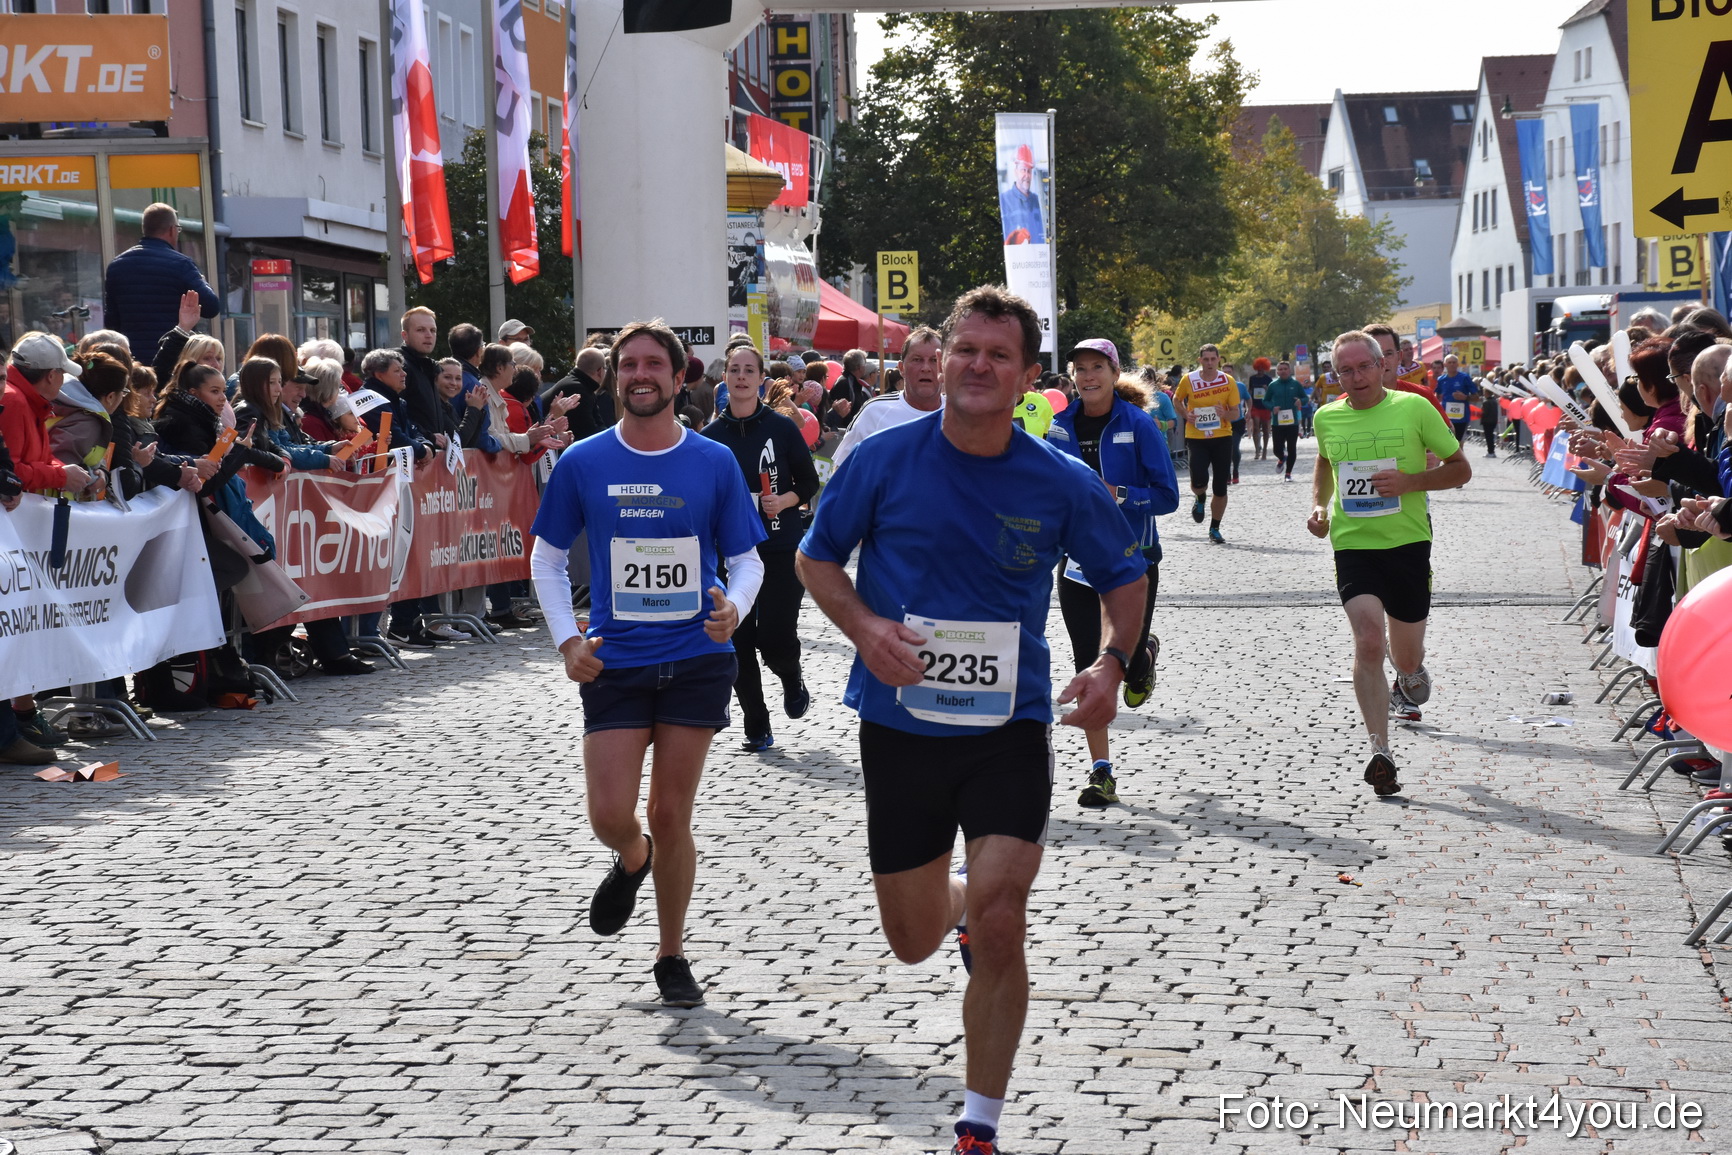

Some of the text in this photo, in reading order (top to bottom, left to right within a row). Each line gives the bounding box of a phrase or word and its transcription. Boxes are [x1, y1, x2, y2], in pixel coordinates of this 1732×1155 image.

[0, 44, 147, 93] KT.DE
[882, 254, 914, 265] Block
[1670, 245, 1694, 277] B
[888, 270, 909, 300] B
[1161, 338, 1173, 355] C
[1473, 347, 1482, 360] D
[1194, 390, 1210, 399] MAX
[1199, 413, 1217, 422] 2612
[1566, 402, 1586, 421] swn
[620, 486, 654, 494] HEUTE
[631, 497, 677, 506] MORGEN
[1355, 500, 1384, 509] Wolfgang
[620, 508, 664, 518] BEWEGEN
[624, 563, 688, 589] 2150
[642, 597, 670, 607] Marco
[945, 630, 986, 641] BOCK
[918, 650, 999, 686] 2235
[936, 693, 976, 707] Hubert
